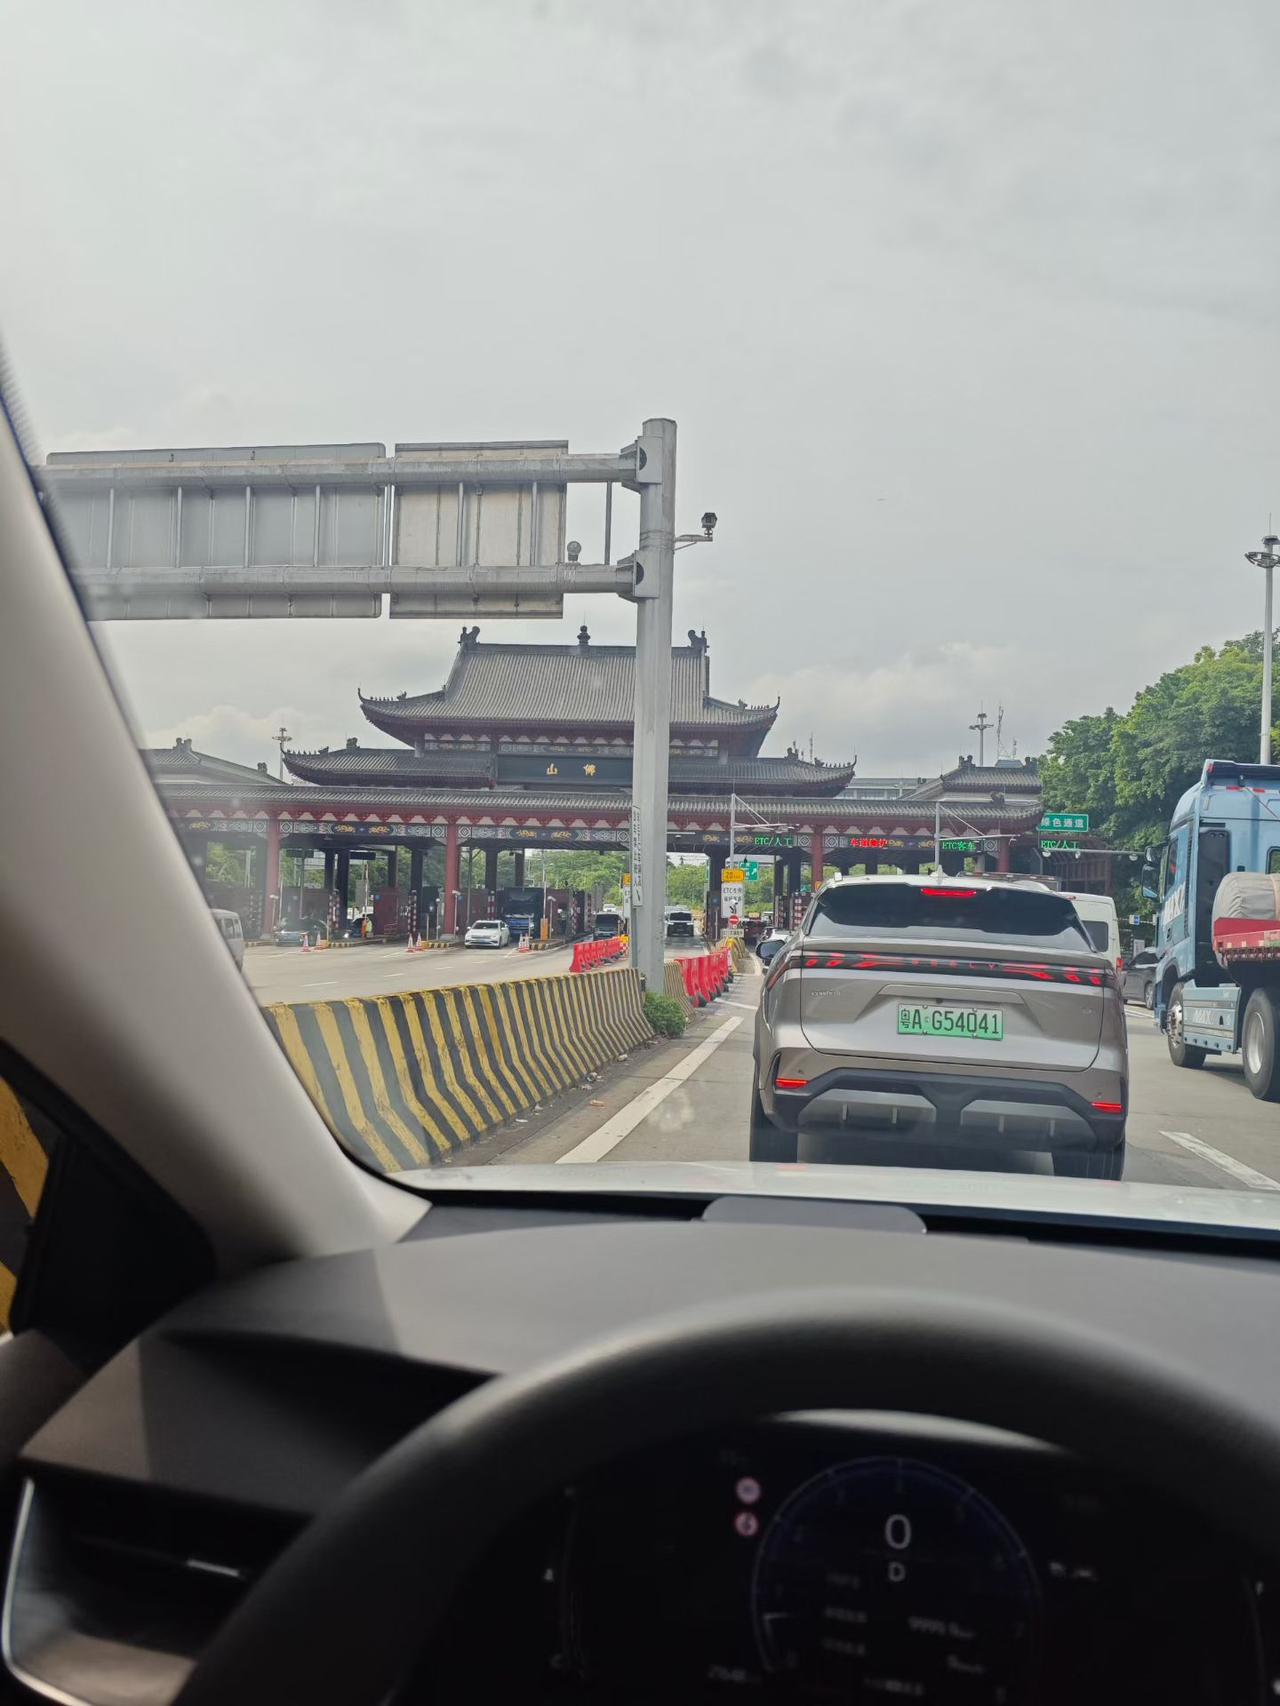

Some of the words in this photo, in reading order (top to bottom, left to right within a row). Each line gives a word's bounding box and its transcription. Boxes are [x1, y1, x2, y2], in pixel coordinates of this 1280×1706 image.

[754, 836, 794, 849] ETC/人工
[885, 1513, 912, 1550] 0
[887, 1561, 906, 1582] D
